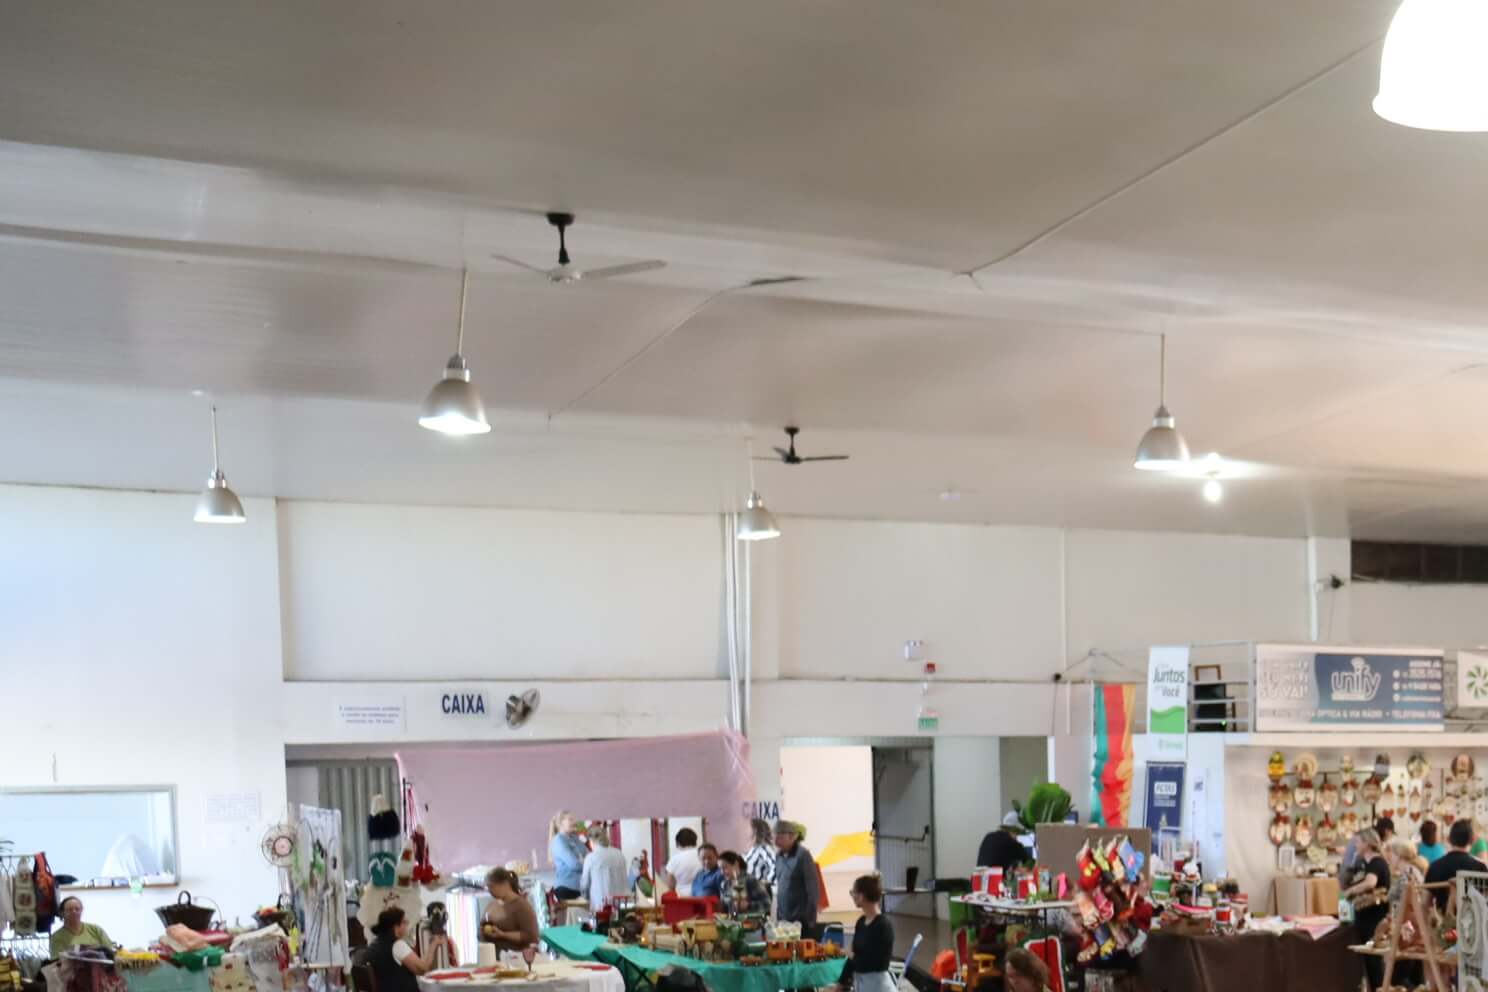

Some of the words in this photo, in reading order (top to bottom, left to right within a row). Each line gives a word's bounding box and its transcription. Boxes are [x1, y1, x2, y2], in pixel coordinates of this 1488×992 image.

[1153, 667, 1185, 683] Juntos
[1331, 658, 1381, 700] unify
[1162, 685, 1180, 697] Você
[441, 694, 485, 714] CAIXA
[741, 801, 780, 820] CAIXA
